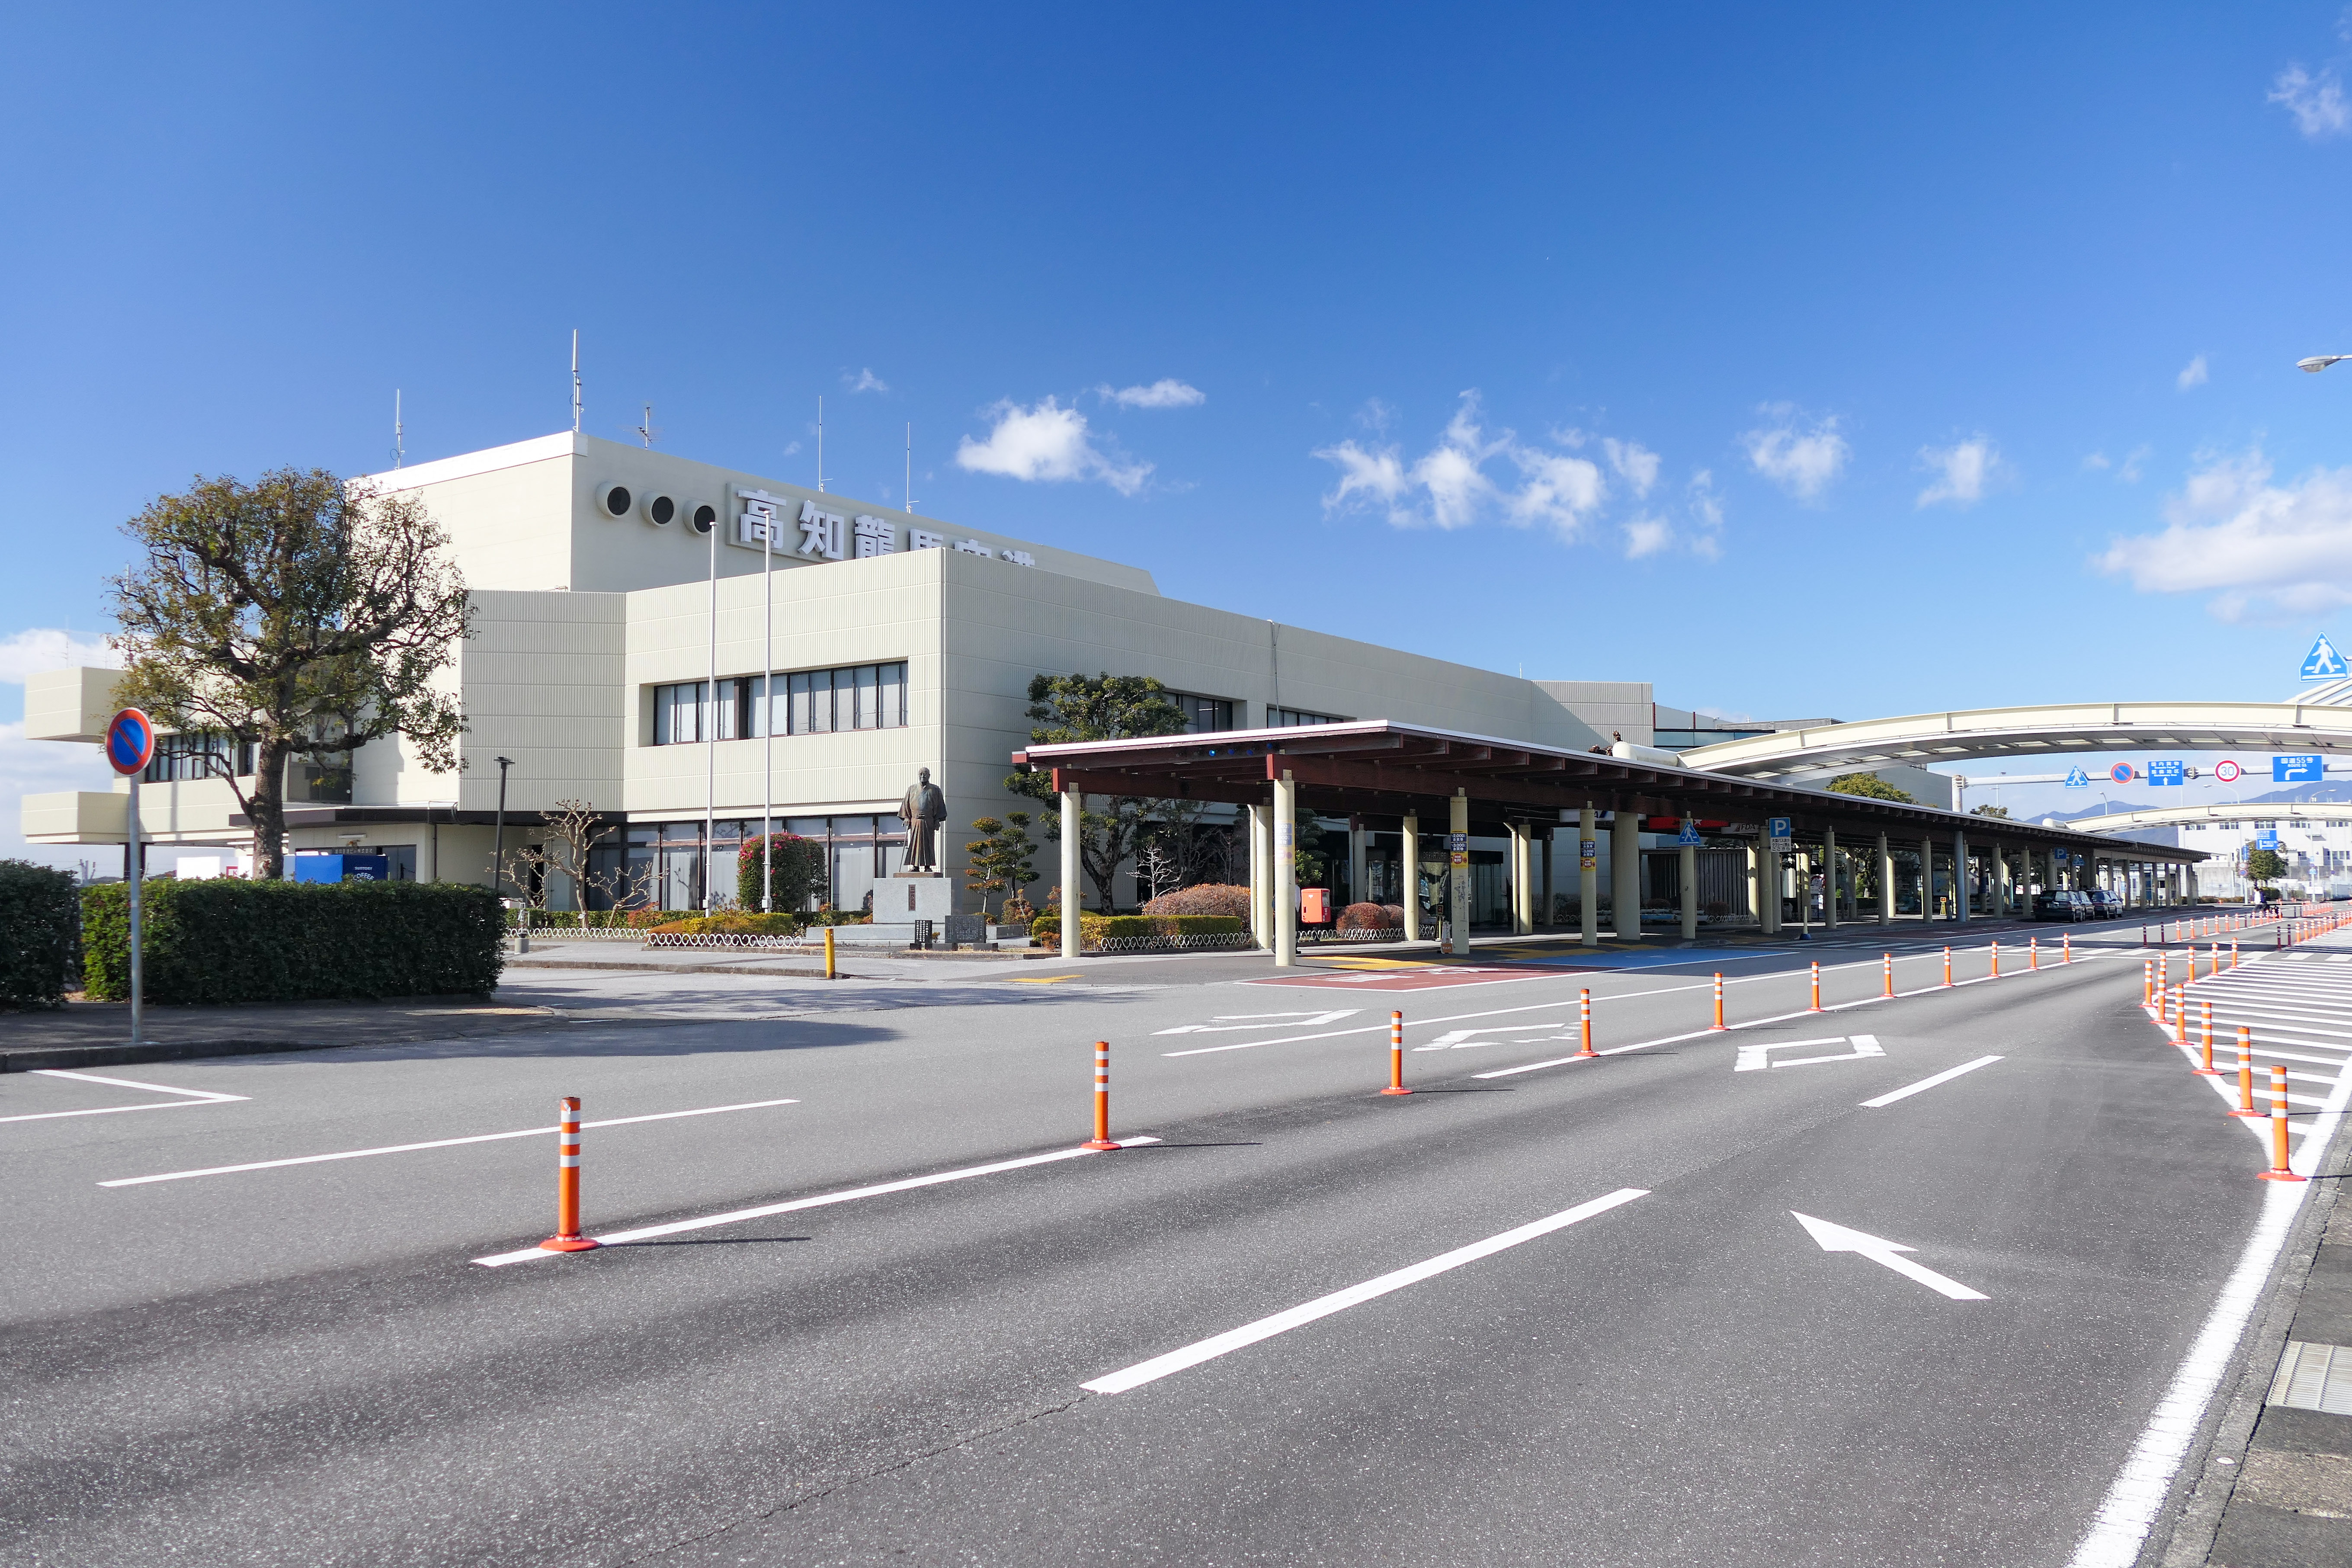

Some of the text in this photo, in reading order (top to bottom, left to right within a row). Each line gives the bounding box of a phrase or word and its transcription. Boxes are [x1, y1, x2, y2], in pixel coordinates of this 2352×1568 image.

[738, 490, 1035, 566] 高知龍
[2221, 766, 2234, 776] 30
[1775, 820, 1787, 836] P
[2057, 849, 2064, 858] P
[353, 872, 375, 881] COFFEE
